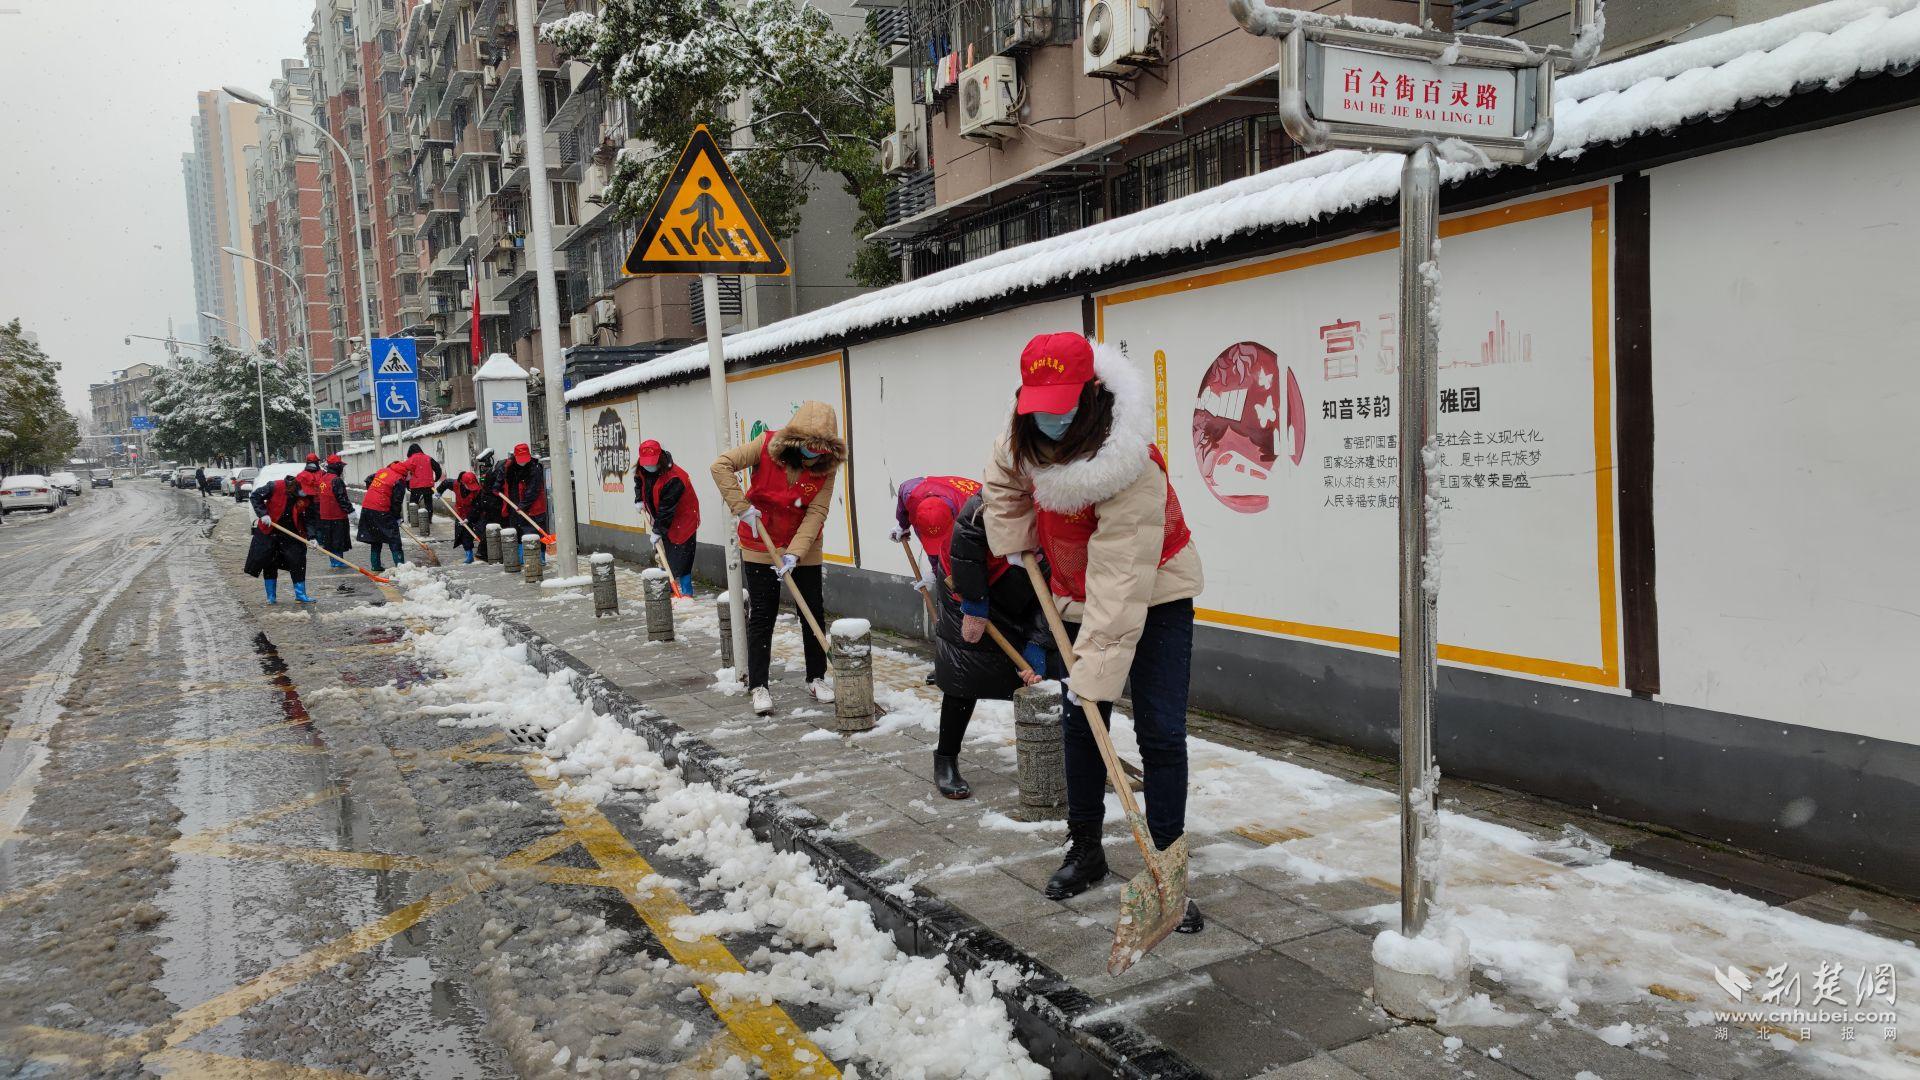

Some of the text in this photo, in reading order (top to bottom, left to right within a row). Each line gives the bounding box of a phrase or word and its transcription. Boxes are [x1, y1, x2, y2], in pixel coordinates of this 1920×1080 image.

[1342, 67, 1497, 110] 百合街百灵路
[1344, 98, 1495, 126] BAI HE JIE BAI LING LU
[1322, 386, 1481, 420] 知音琴韵 雅园
[1323, 455, 1398, 469] 国家经济建设的
